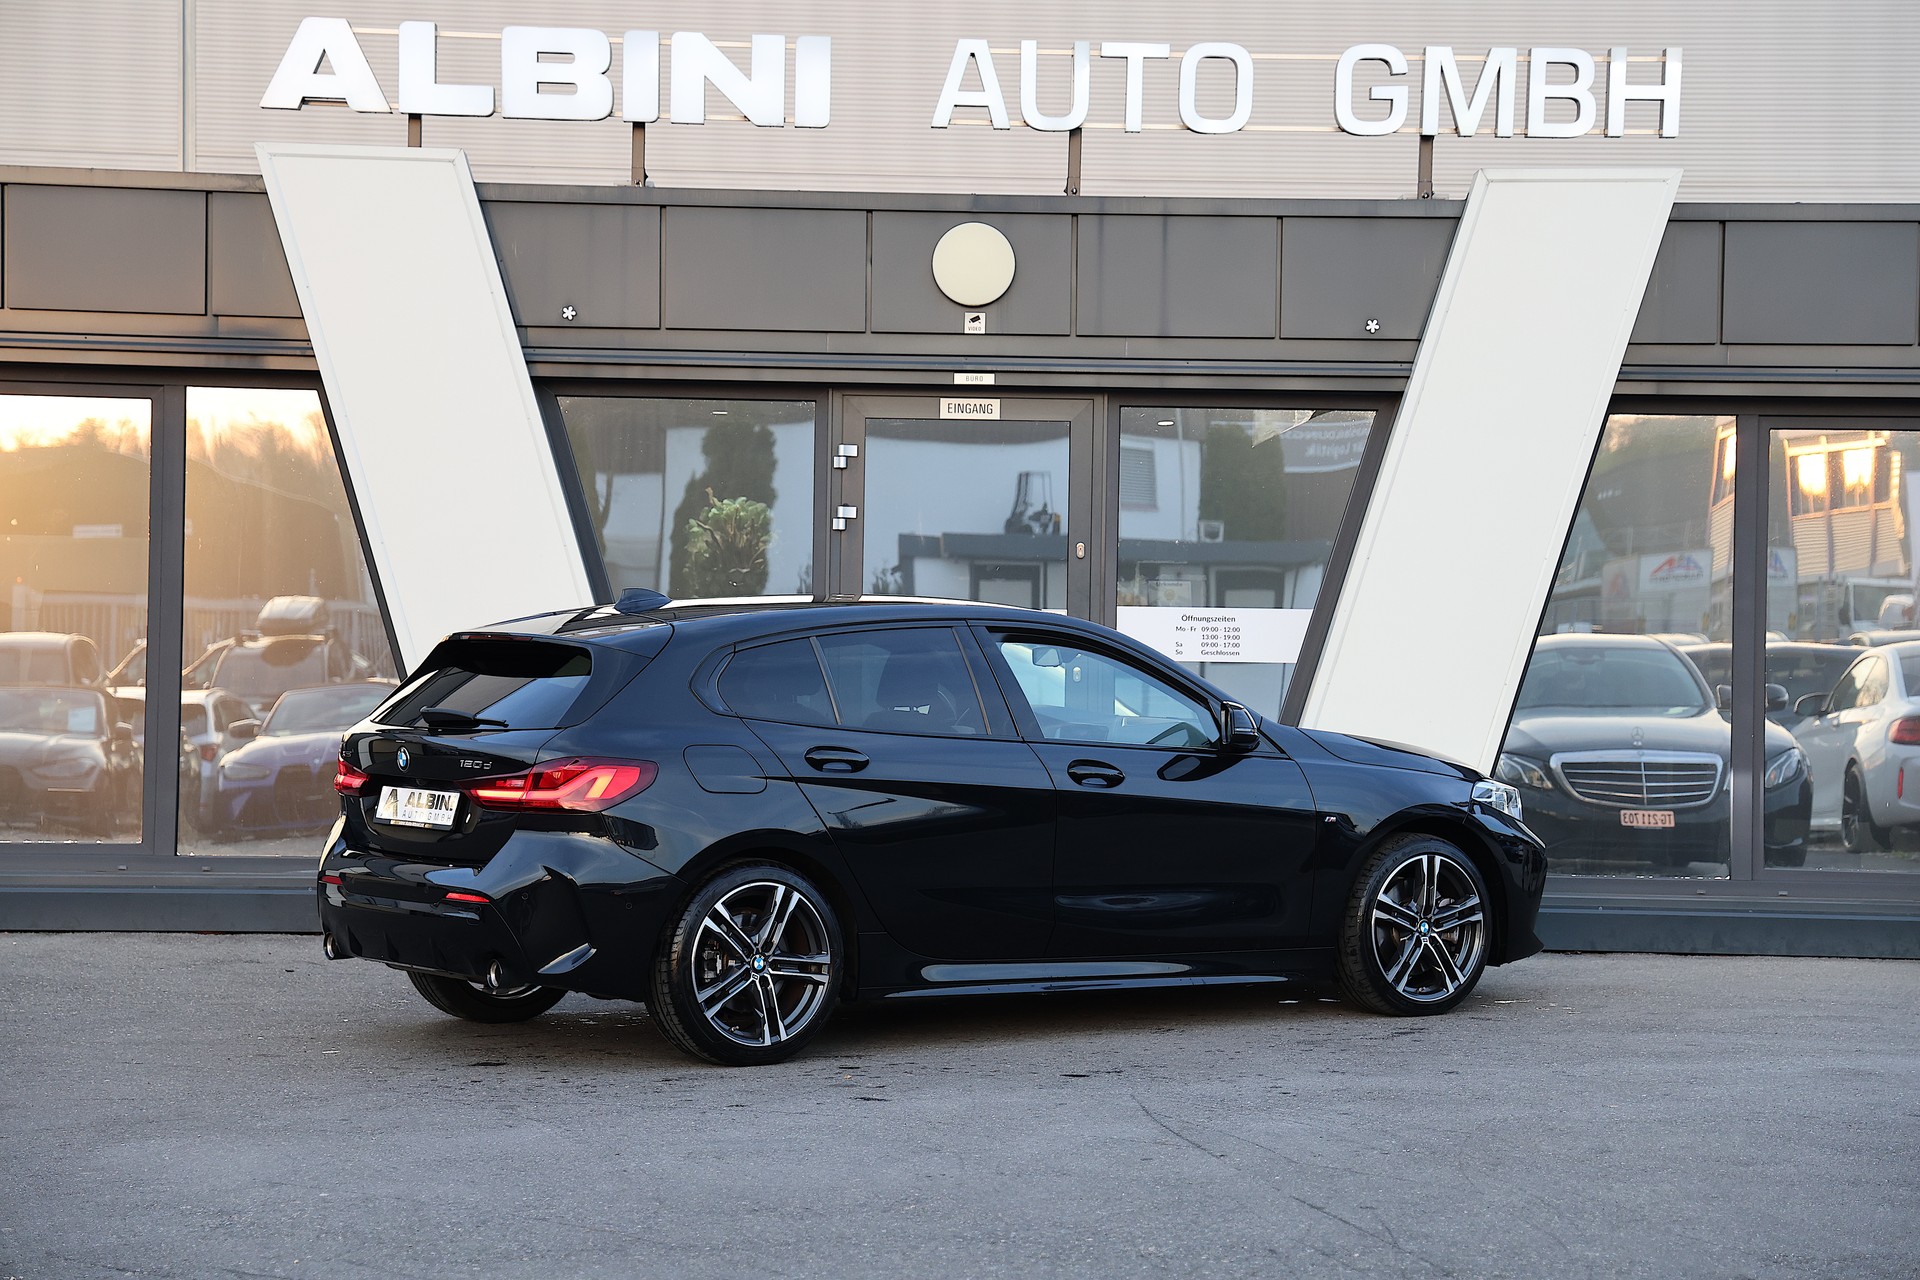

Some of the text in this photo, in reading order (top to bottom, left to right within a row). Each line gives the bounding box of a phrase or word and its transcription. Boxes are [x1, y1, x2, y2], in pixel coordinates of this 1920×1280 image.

[259, 16, 1683, 138] ALBINI AUTO GMBH
[947, 403, 993, 414] EINGANG
[1181, 614, 1236, 623] Öffnungszeiten
